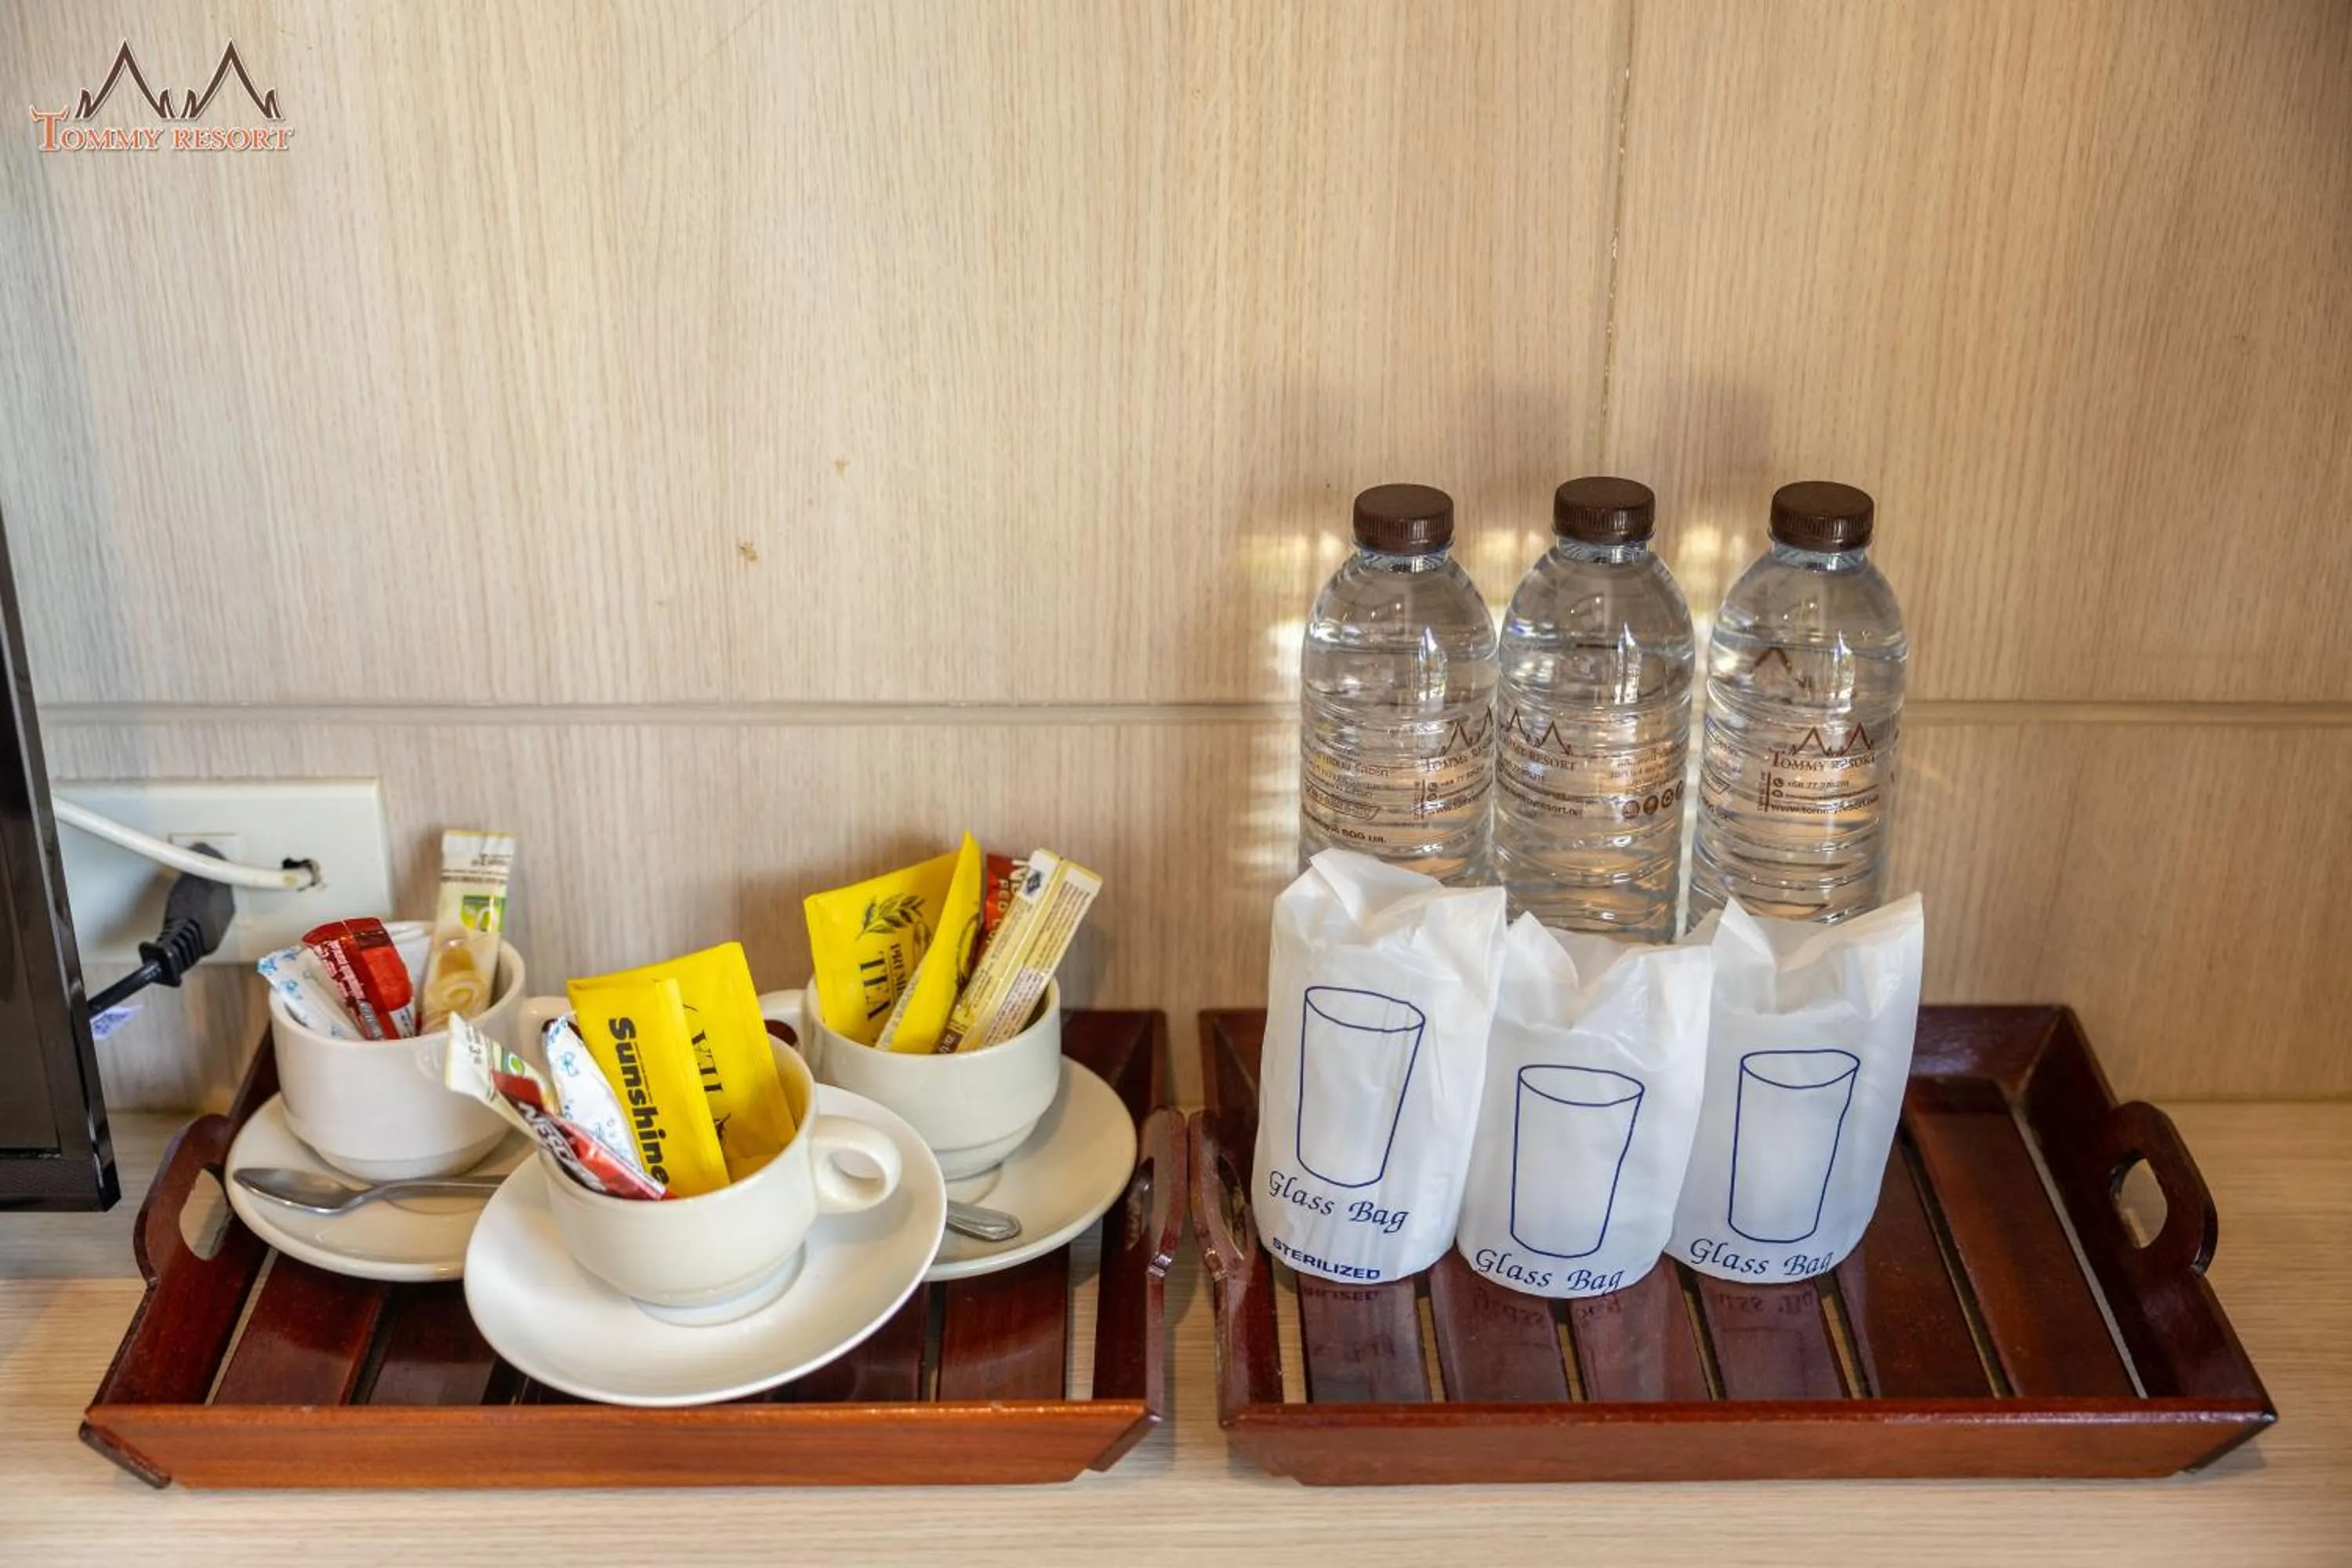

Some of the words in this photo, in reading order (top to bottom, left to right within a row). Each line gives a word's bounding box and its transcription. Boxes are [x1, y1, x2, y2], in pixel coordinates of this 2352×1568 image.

[1769, 747, 1825, 771] TOMMY
[608, 1017, 670, 1185] Sunshine
[1269, 1171, 1335, 1216] Glass
[1348, 1200, 1410, 1234] Bag
[1272, 1236, 1381, 1280] STERILIZED
[1475, 1248, 1553, 1288] Glass
[1566, 1269, 1627, 1296] Bag
[1690, 1238, 1769, 1275] Glass
